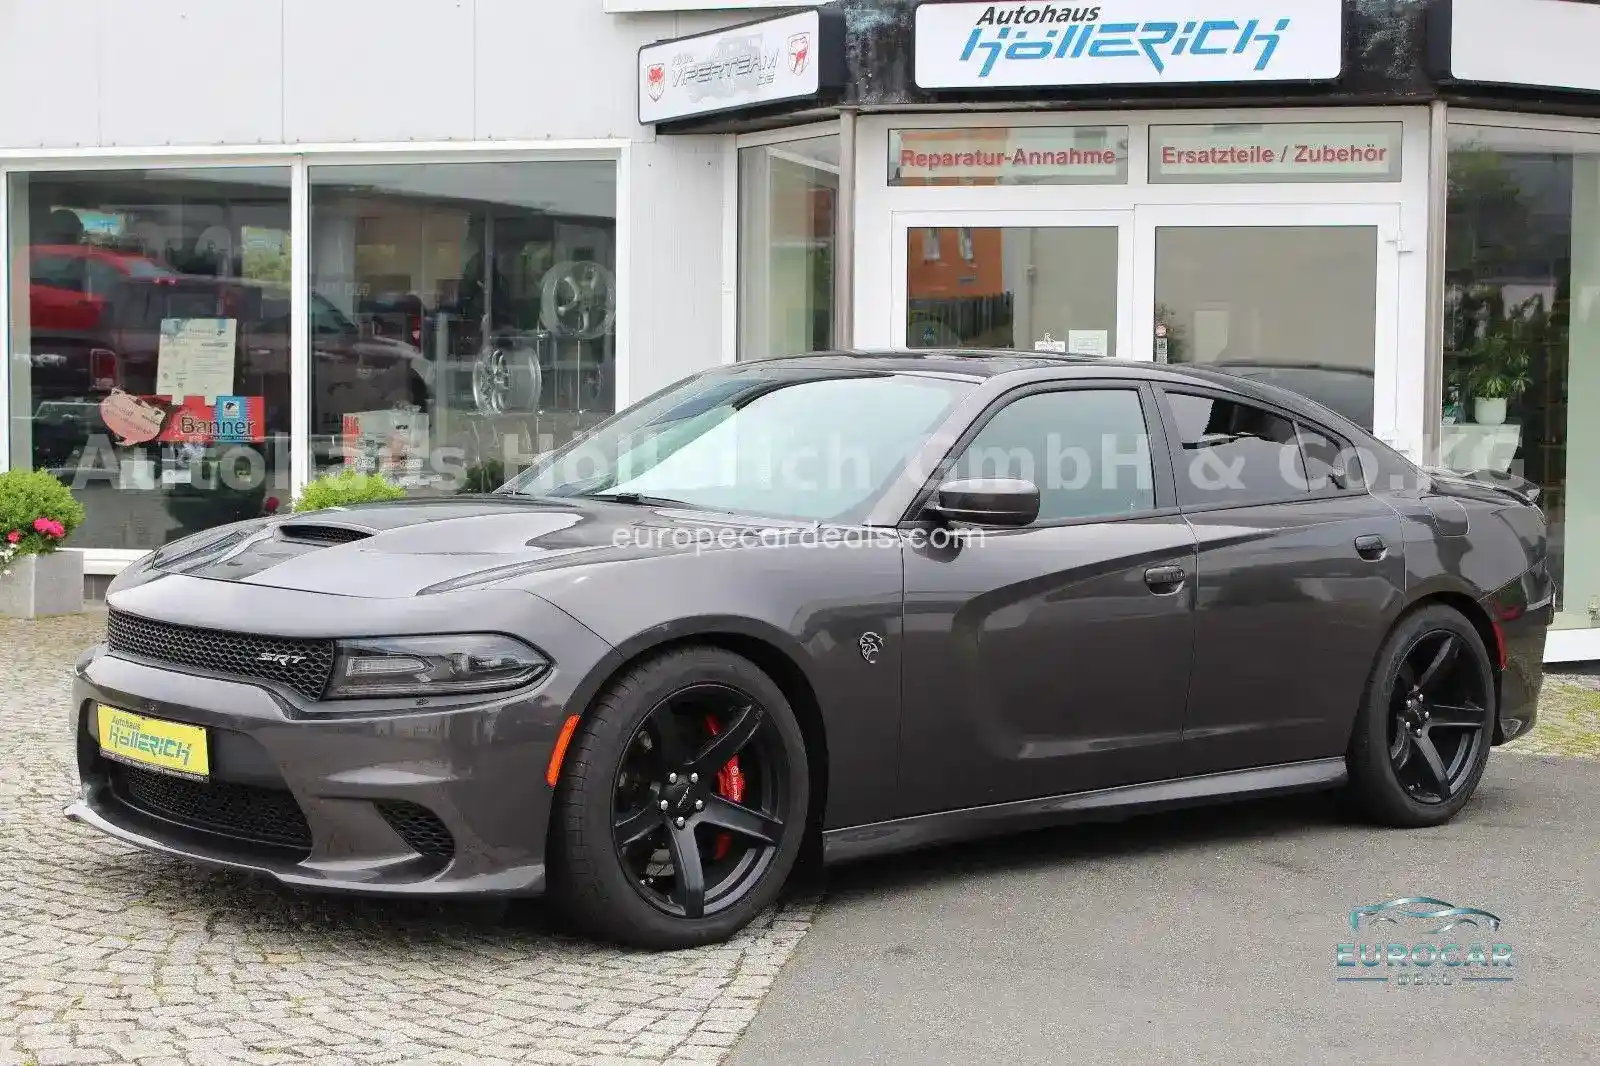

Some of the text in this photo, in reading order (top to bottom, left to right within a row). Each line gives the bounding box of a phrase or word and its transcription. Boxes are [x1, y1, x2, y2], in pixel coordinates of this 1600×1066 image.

[976, 3, 1101, 26] Autohaus
[901, 147, 1116, 169] Reparatur-Annahme
[1162, 145, 1275, 165] Ersatzteile
[1294, 143, 1388, 164] Zubehör
[181, 416, 256, 434] Banner
[256, 652, 307, 666] SRT
